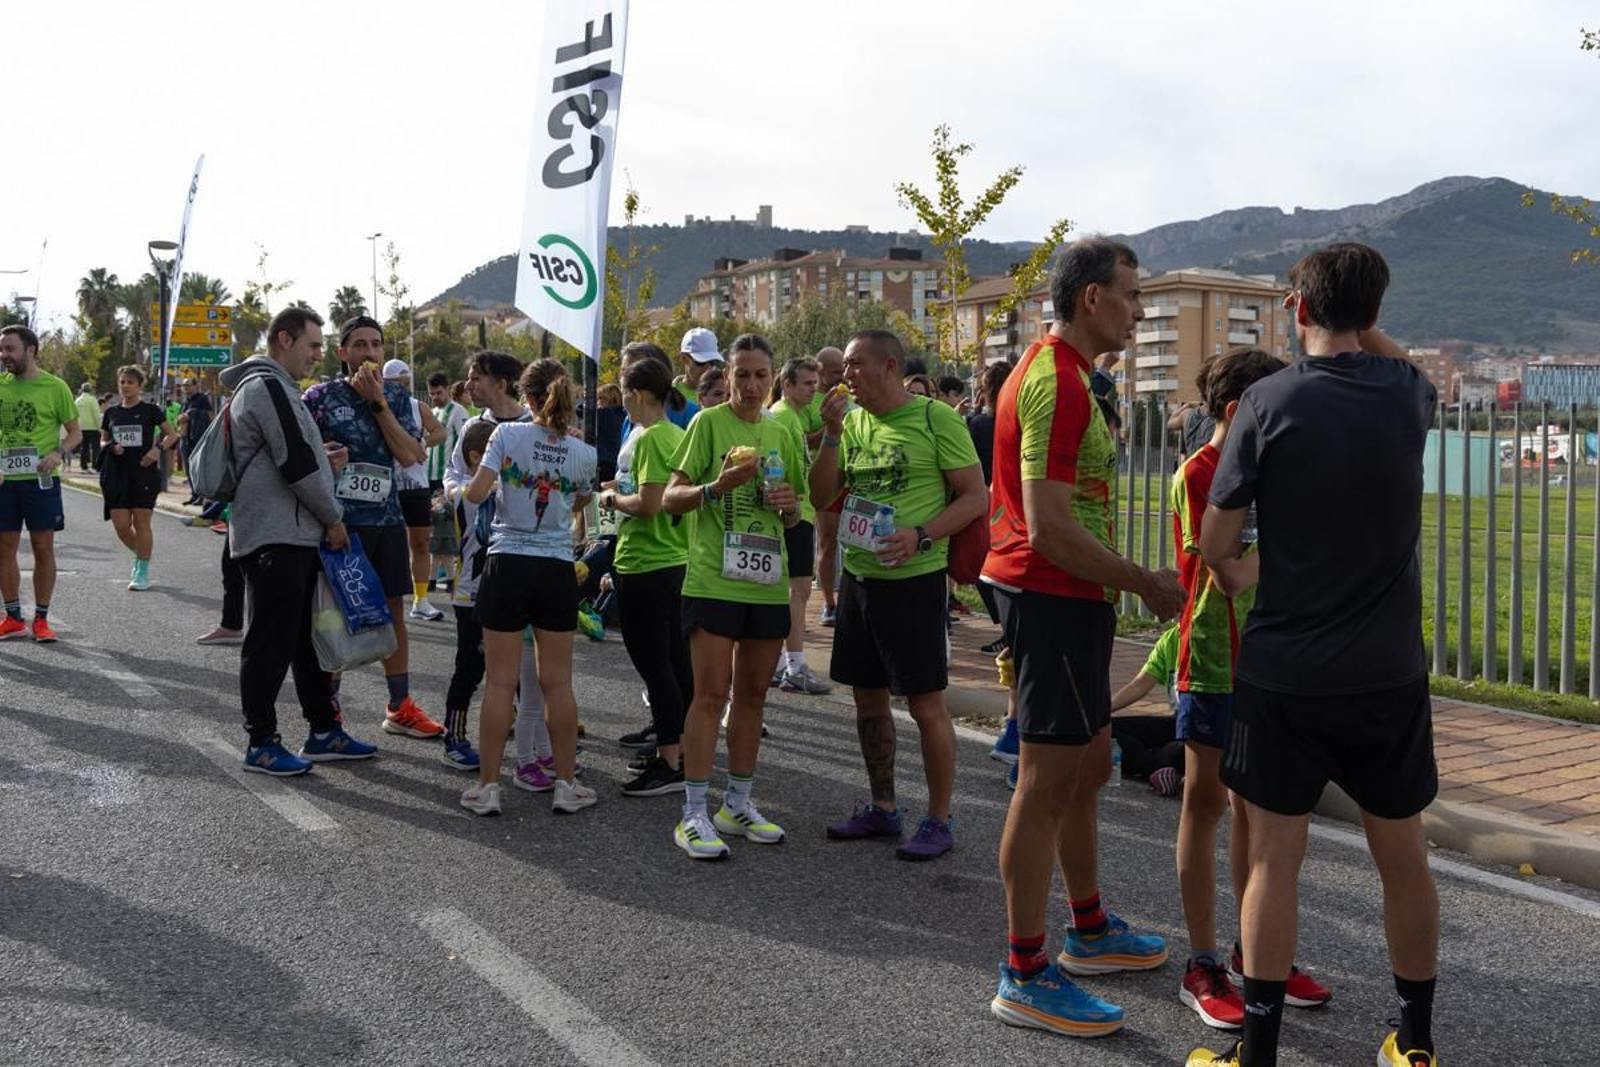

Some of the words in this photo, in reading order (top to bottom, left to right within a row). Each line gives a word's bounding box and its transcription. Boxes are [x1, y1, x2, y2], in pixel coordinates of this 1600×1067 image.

[8, 456, 31, 469] 208
[350, 476, 380, 493] 308
[737, 551, 772, 573] 356
[1001, 983, 1033, 1005] HOKA
